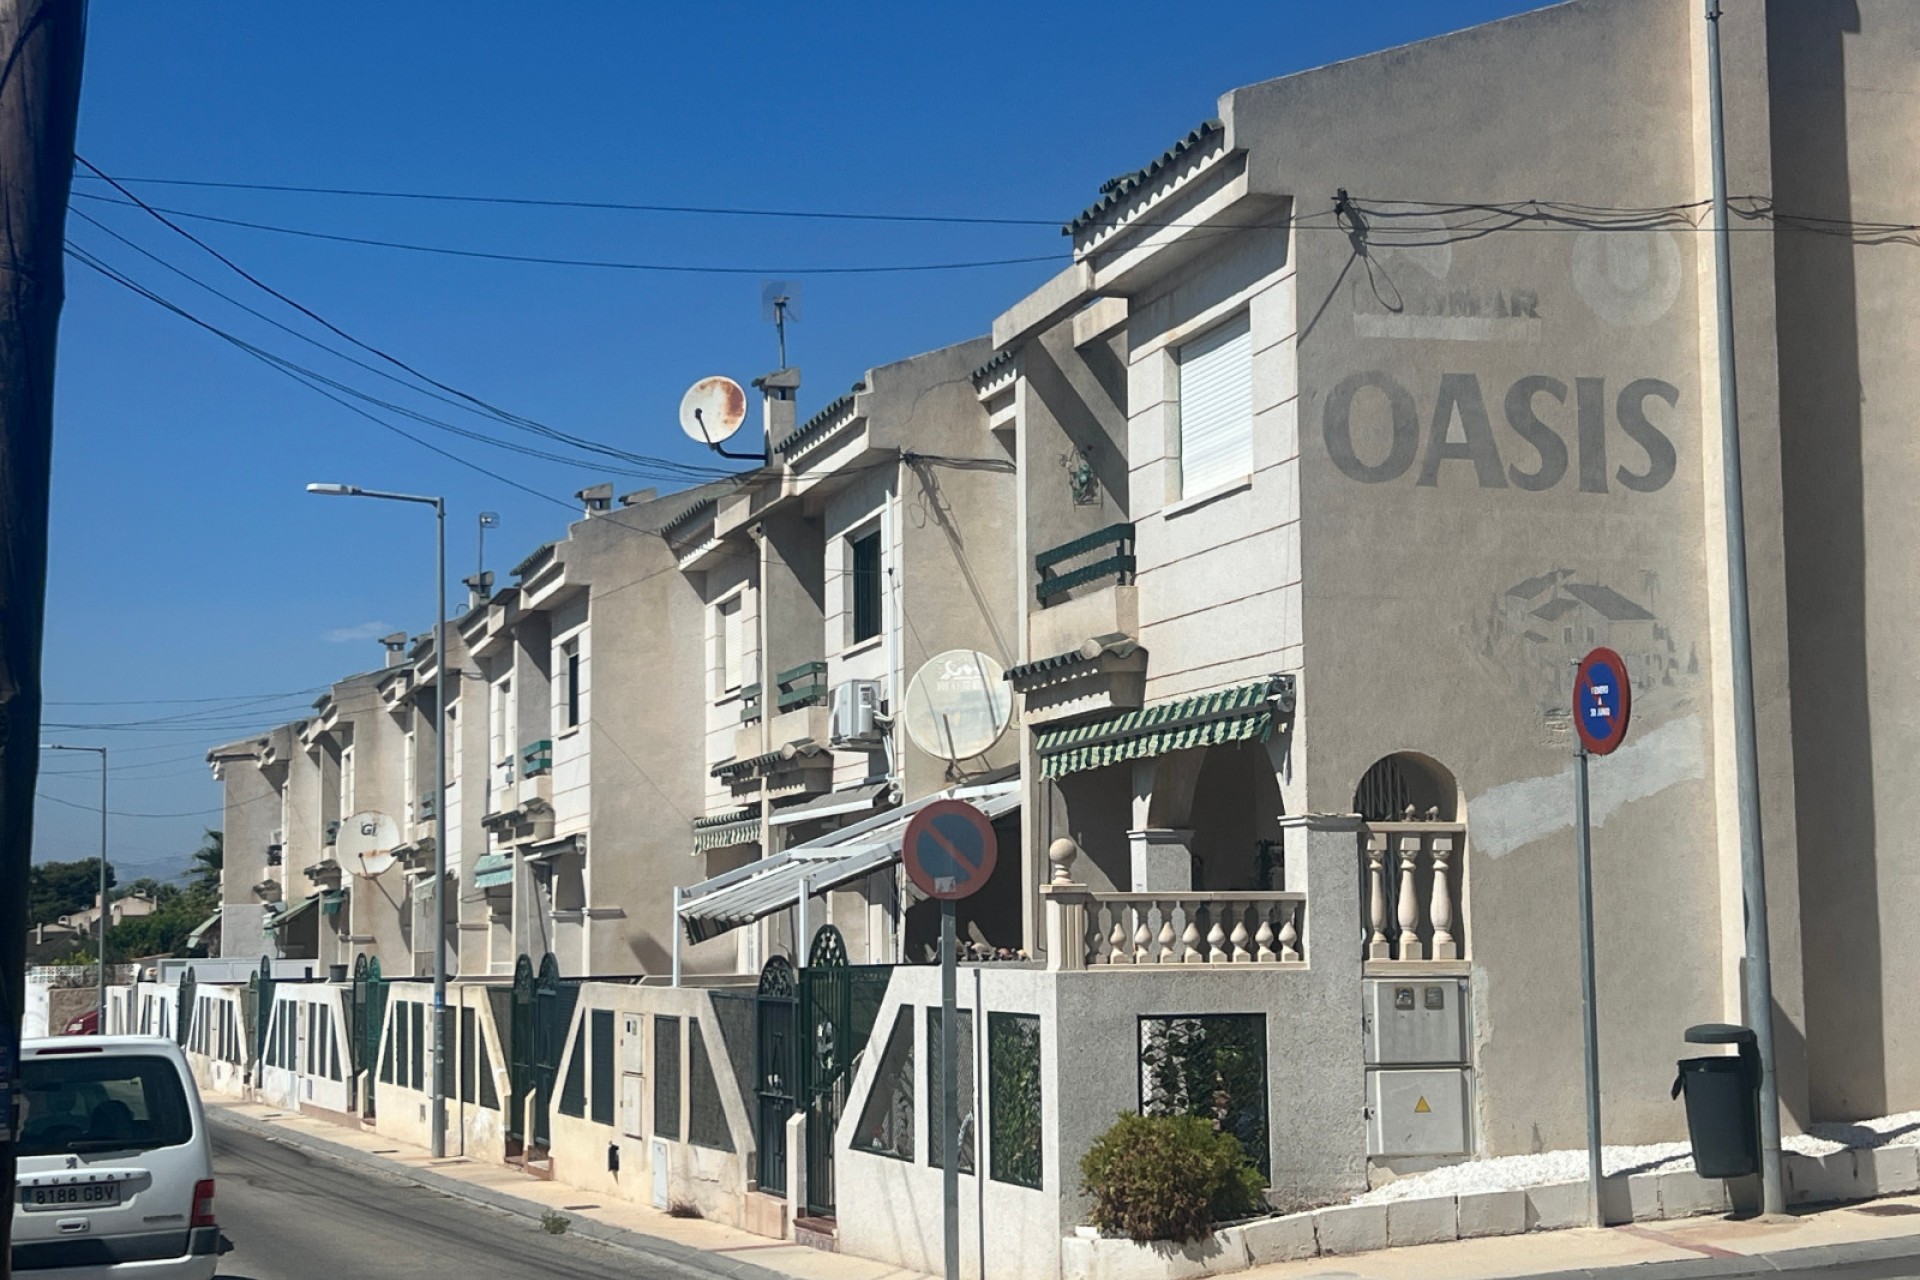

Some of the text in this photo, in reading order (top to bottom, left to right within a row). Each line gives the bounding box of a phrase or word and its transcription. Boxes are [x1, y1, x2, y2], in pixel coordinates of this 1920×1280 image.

[1322, 371, 1680, 494] OASIS
[36, 1185, 114, 1204] 8188 GBV
